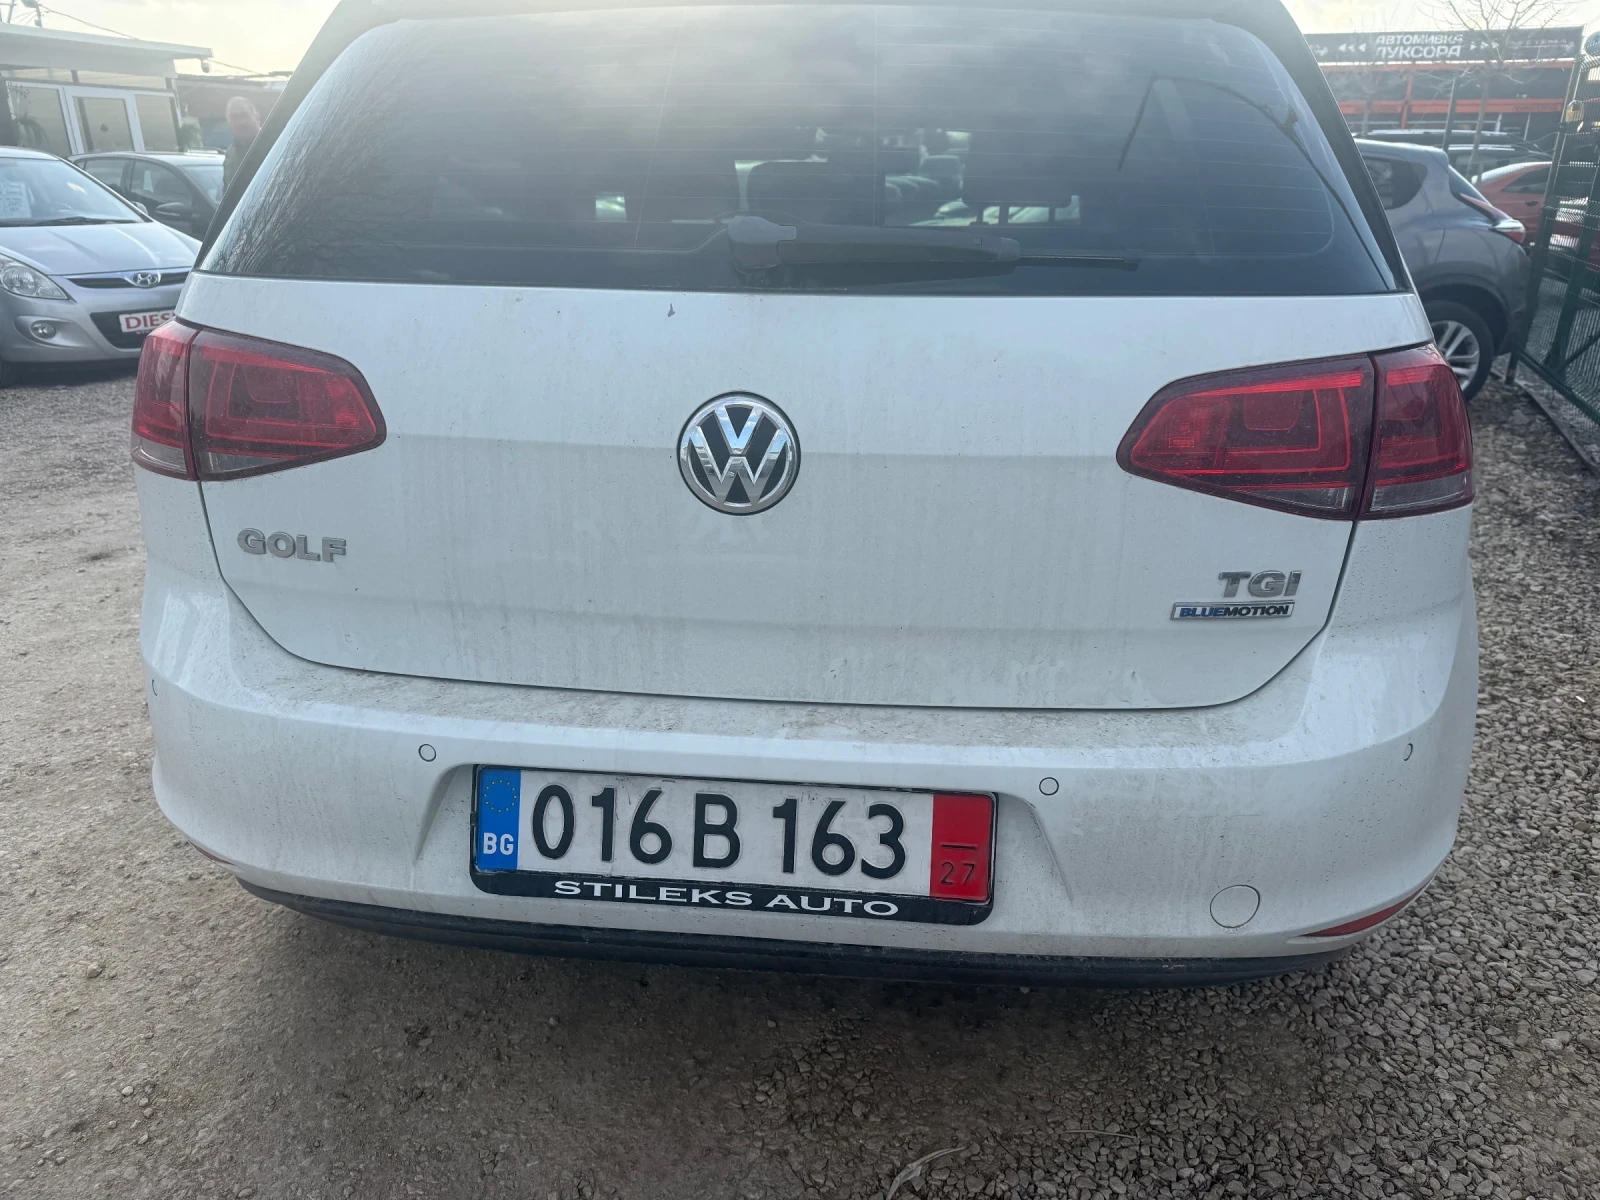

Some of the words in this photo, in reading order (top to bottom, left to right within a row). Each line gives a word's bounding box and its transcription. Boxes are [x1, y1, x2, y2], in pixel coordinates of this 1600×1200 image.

[1376, 33, 1464, 46] АВТОМИВКА
[1375, 45, 1462, 59] ЛУКСОРА
[125, 312, 175, 329] DIES
[237, 528, 347, 562] GOLF
[1218, 570, 1303, 598] TGI
[1179, 605, 1290, 618] BLUEMOTION
[483, 832, 514, 855] BG
[532, 784, 672, 865] 016
[693, 792, 742, 869] B
[773, 798, 906, 879] 163
[940, 861, 976, 886] 27
[554, 880, 753, 907] STILEKS
[765, 894, 899, 916] AUTO
